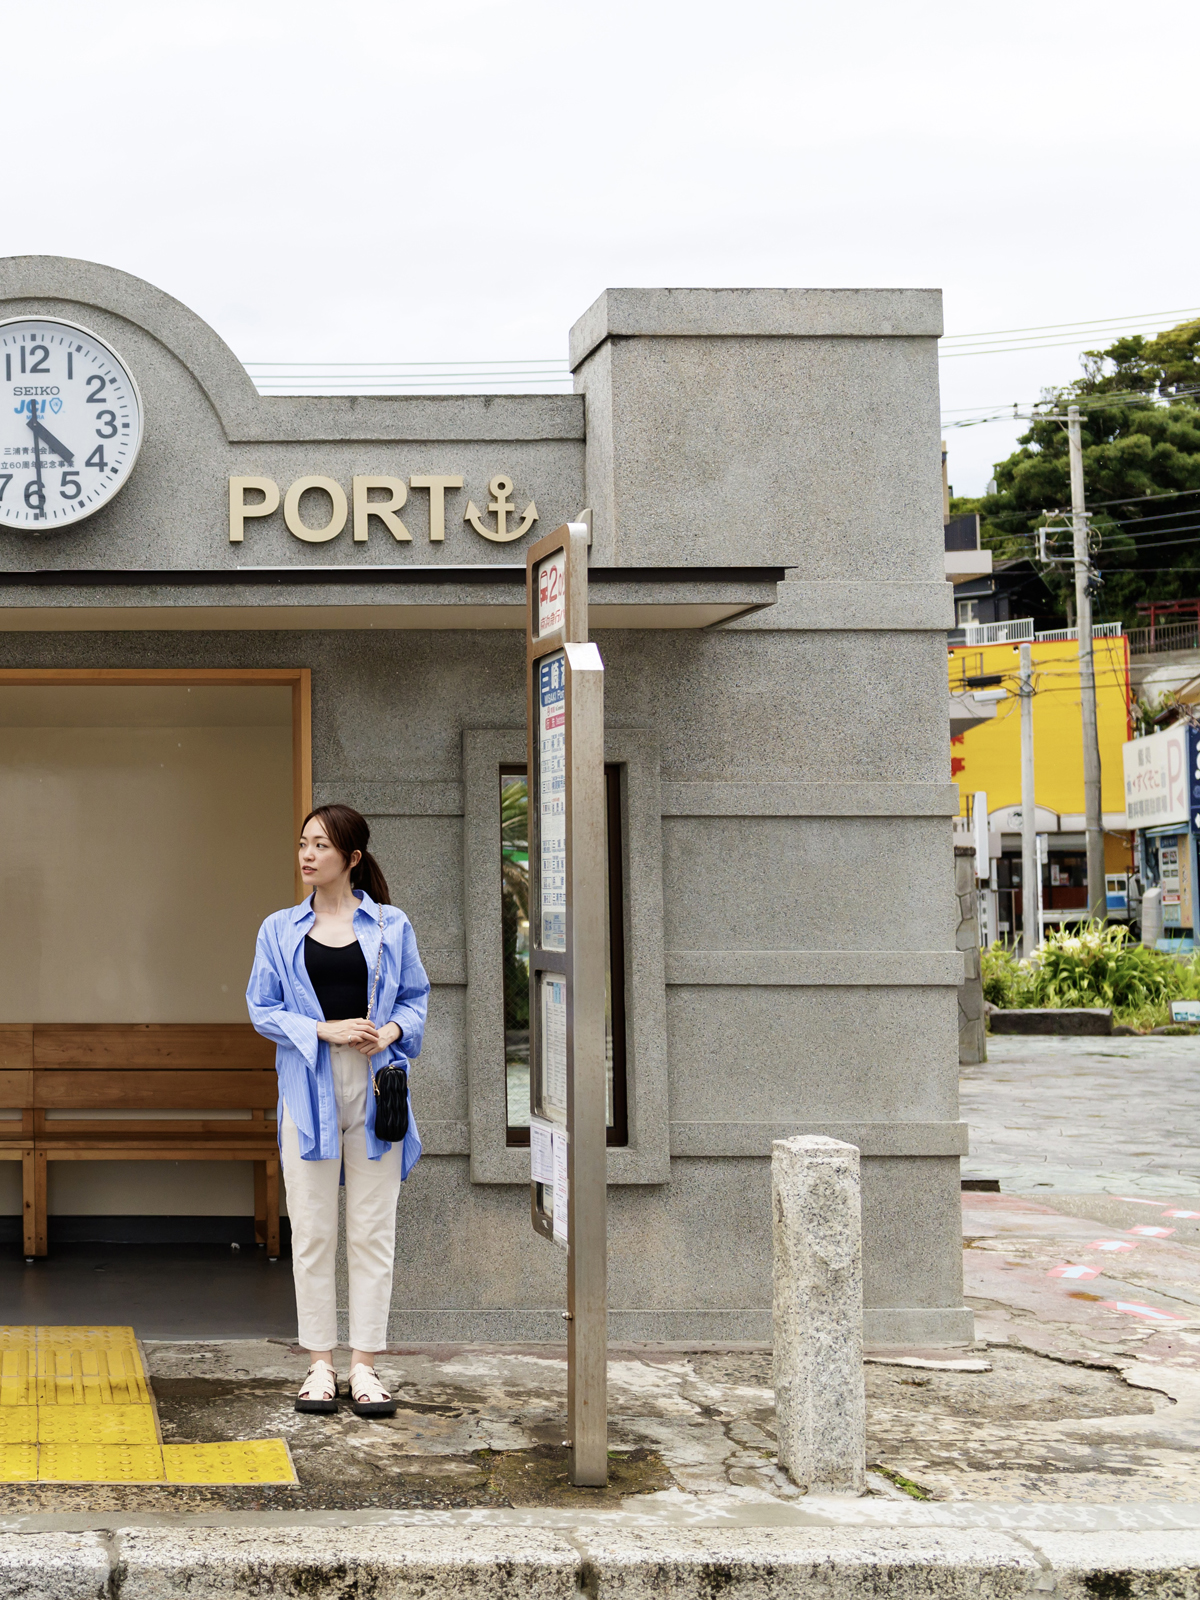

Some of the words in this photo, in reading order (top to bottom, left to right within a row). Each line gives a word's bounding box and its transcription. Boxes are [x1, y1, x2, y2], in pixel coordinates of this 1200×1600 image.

[20, 345, 50, 374] 12
[67, 352, 73, 380] 1
[13, 386, 60, 396] SEIKO
[86, 374, 107, 403] 2
[14, 399, 47, 415] JCI
[95, 409, 118, 439] 3
[84, 444, 108, 473] 4
[24, 480, 46, 510] 6
[60, 471, 82, 500] 5
[229, 475, 464, 543] PORT
[1167, 739, 1182, 812] P
